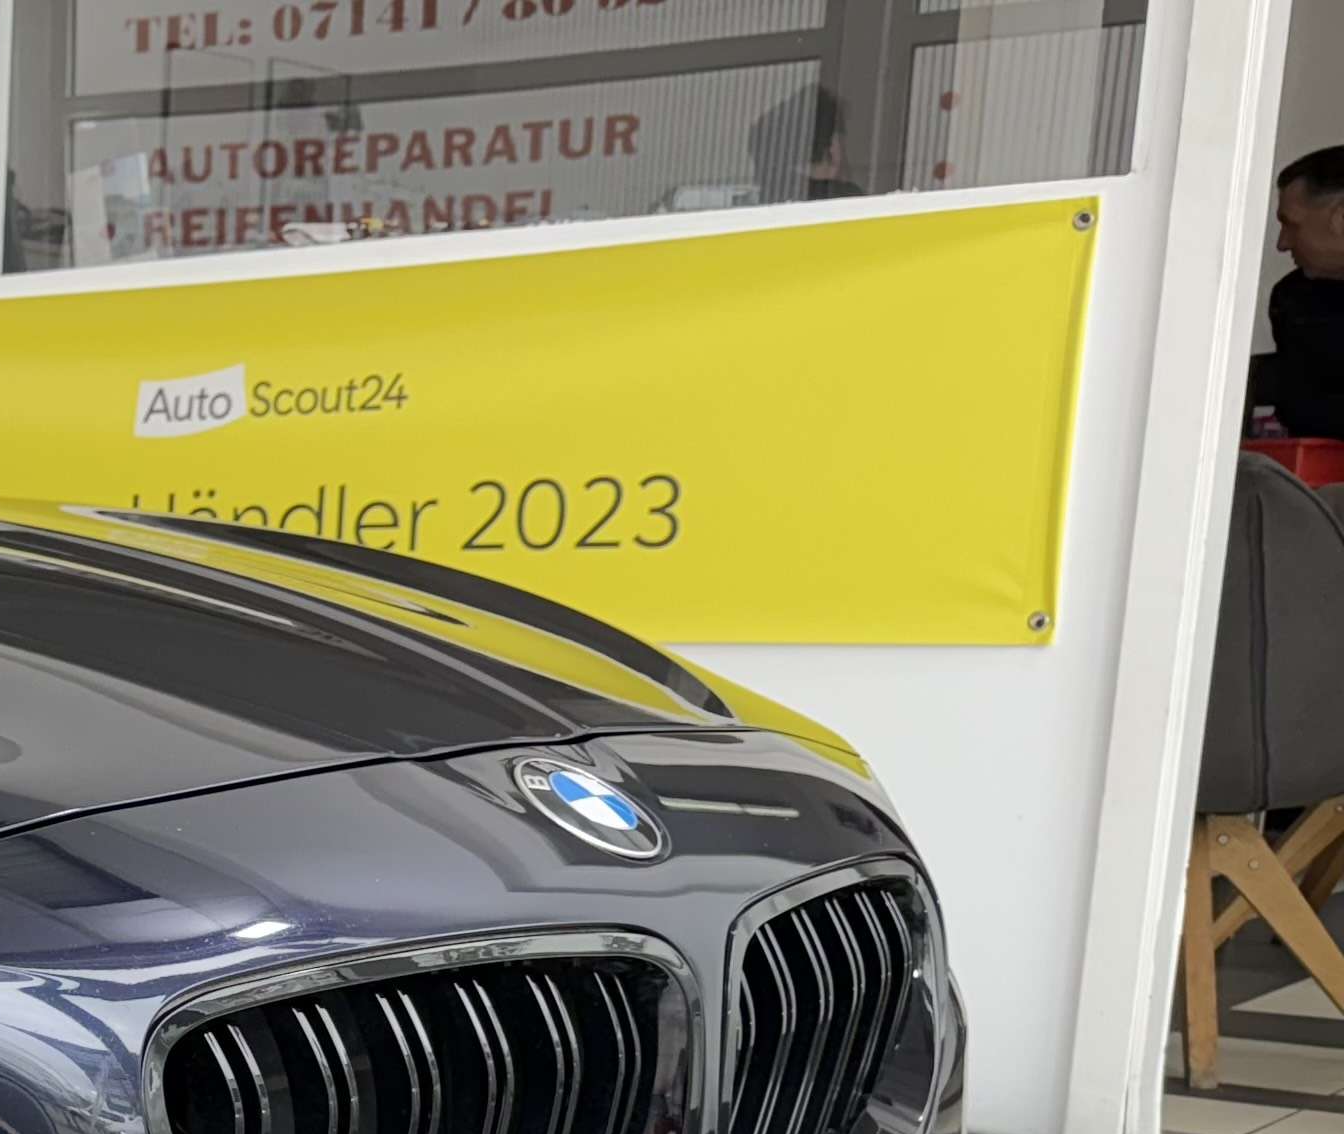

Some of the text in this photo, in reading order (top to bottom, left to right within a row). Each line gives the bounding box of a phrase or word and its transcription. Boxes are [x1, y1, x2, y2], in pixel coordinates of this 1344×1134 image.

[125, 13, 252, 53] TEL:
[149, 114, 641, 185] AUTOREPARATUR
[461, 473, 682, 551] 2023
